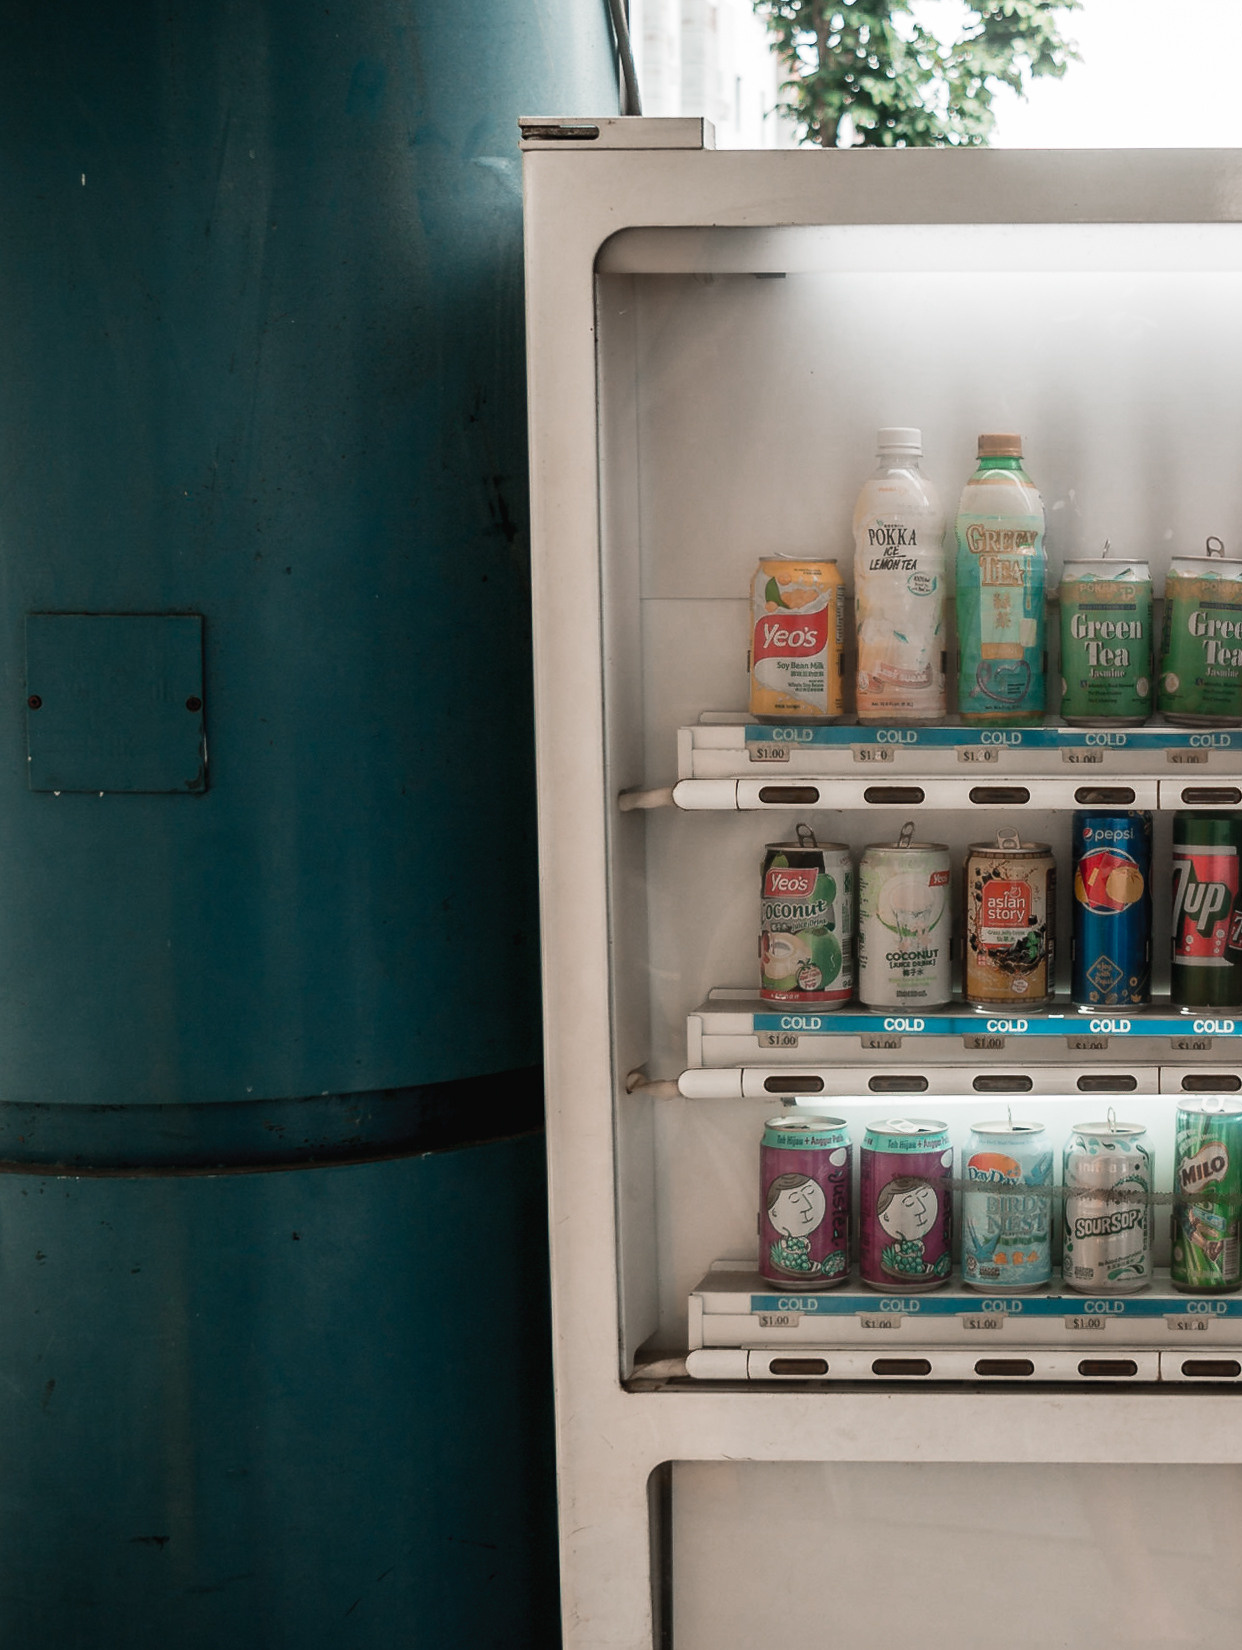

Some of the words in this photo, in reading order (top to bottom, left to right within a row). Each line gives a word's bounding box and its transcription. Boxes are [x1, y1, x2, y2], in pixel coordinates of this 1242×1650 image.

[868, 528, 917, 546] POKKA
[883, 546, 899, 556] ICE
[869, 559, 900, 571] LEMON
[902, 559, 917, 570] TEA
[979, 554, 1025, 586] TEA
[1071, 613, 1143, 639] Green
[763, 624, 818, 648] Yeo's
[1085, 641, 1130, 667] Tea
[777, 661, 790, 670] Soy
[1089, 668, 1126, 677] Jasmine
[1205, 668, 1239, 678] Jasmine
[773, 728, 813, 741] COLD
[877, 730, 916, 743] COLD
[981, 732, 1021, 745] COLD
[1086, 734, 1126, 746] COLD
[1190, 735, 1230, 747] COLD
[757, 748, 783, 759] $1.00
[1095, 828, 1135, 842] pepsi
[772, 873, 808, 892] Yeo's
[988, 892, 1026, 908] asian
[1173, 860, 1226, 937] 7up
[988, 908, 1025, 923] story
[886, 949, 939, 961] COCONUT
[781, 1017, 821, 1030] COLD
[884, 1018, 924, 1031] COLD
[987, 1019, 1027, 1032] COLD
[1090, 1020, 1131, 1033] COLD
[1193, 1020, 1234, 1033] COLD
[769, 1036, 795, 1046] $1.00
[975, 1038, 1002, 1049] $1.00
[811, 1136, 832, 1146] Anggur
[1181, 1156, 1226, 1188] MILO
[987, 1214, 1045, 1234] NEST
[1075, 1210, 1139, 1239] SOURSOP
[778, 1298, 817, 1311] COLD
[880, 1300, 919, 1312] COLD
[982, 1300, 1022, 1312] COLD
[1084, 1301, 1124, 1313] COLD
[1187, 1301, 1227, 1313] COLD
[763, 1316, 789, 1326] $1.00
[970, 1319, 996, 1329] $1.00
[1074, 1318, 1100, 1329] $1.00
